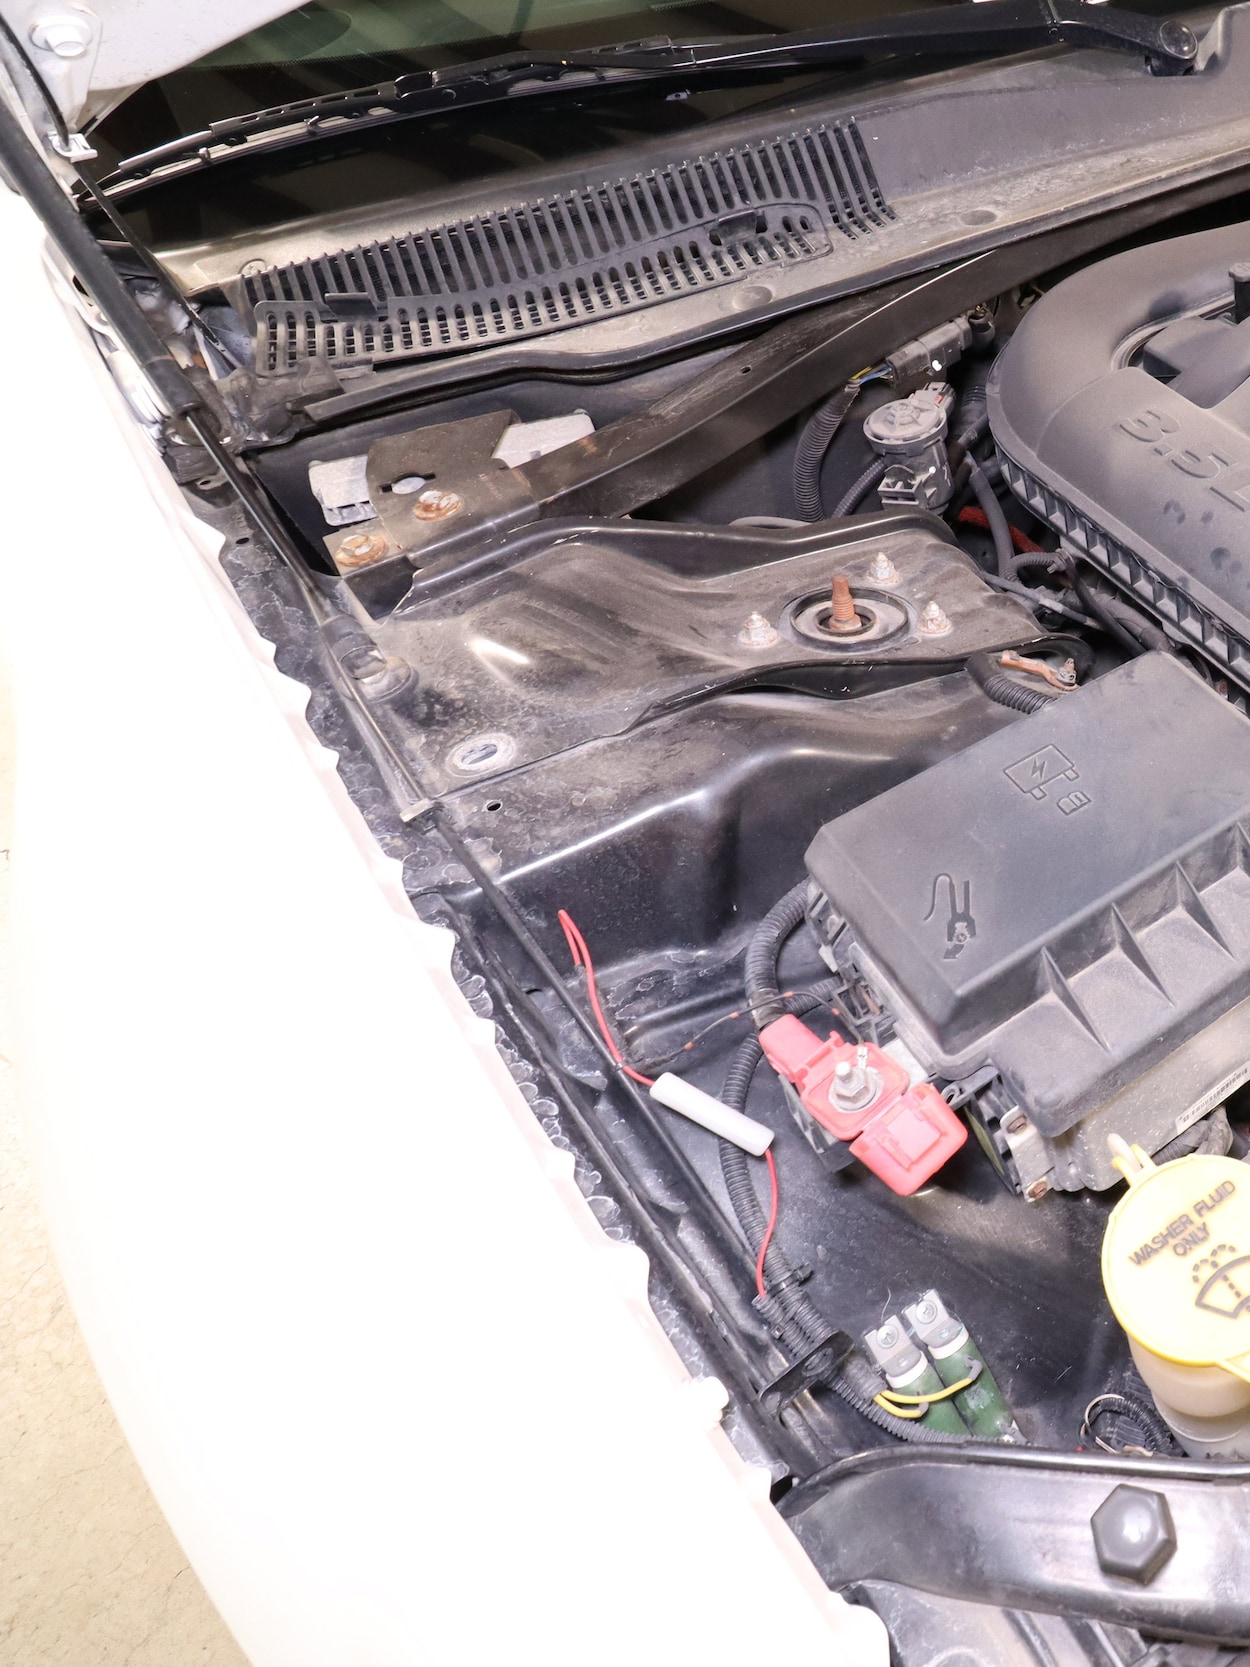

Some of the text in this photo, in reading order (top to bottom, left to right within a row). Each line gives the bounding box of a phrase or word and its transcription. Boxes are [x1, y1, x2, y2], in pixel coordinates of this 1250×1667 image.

[1128, 1180, 1236, 1266] WASHER FLUID
[1172, 1222, 1210, 1257] ONLY
